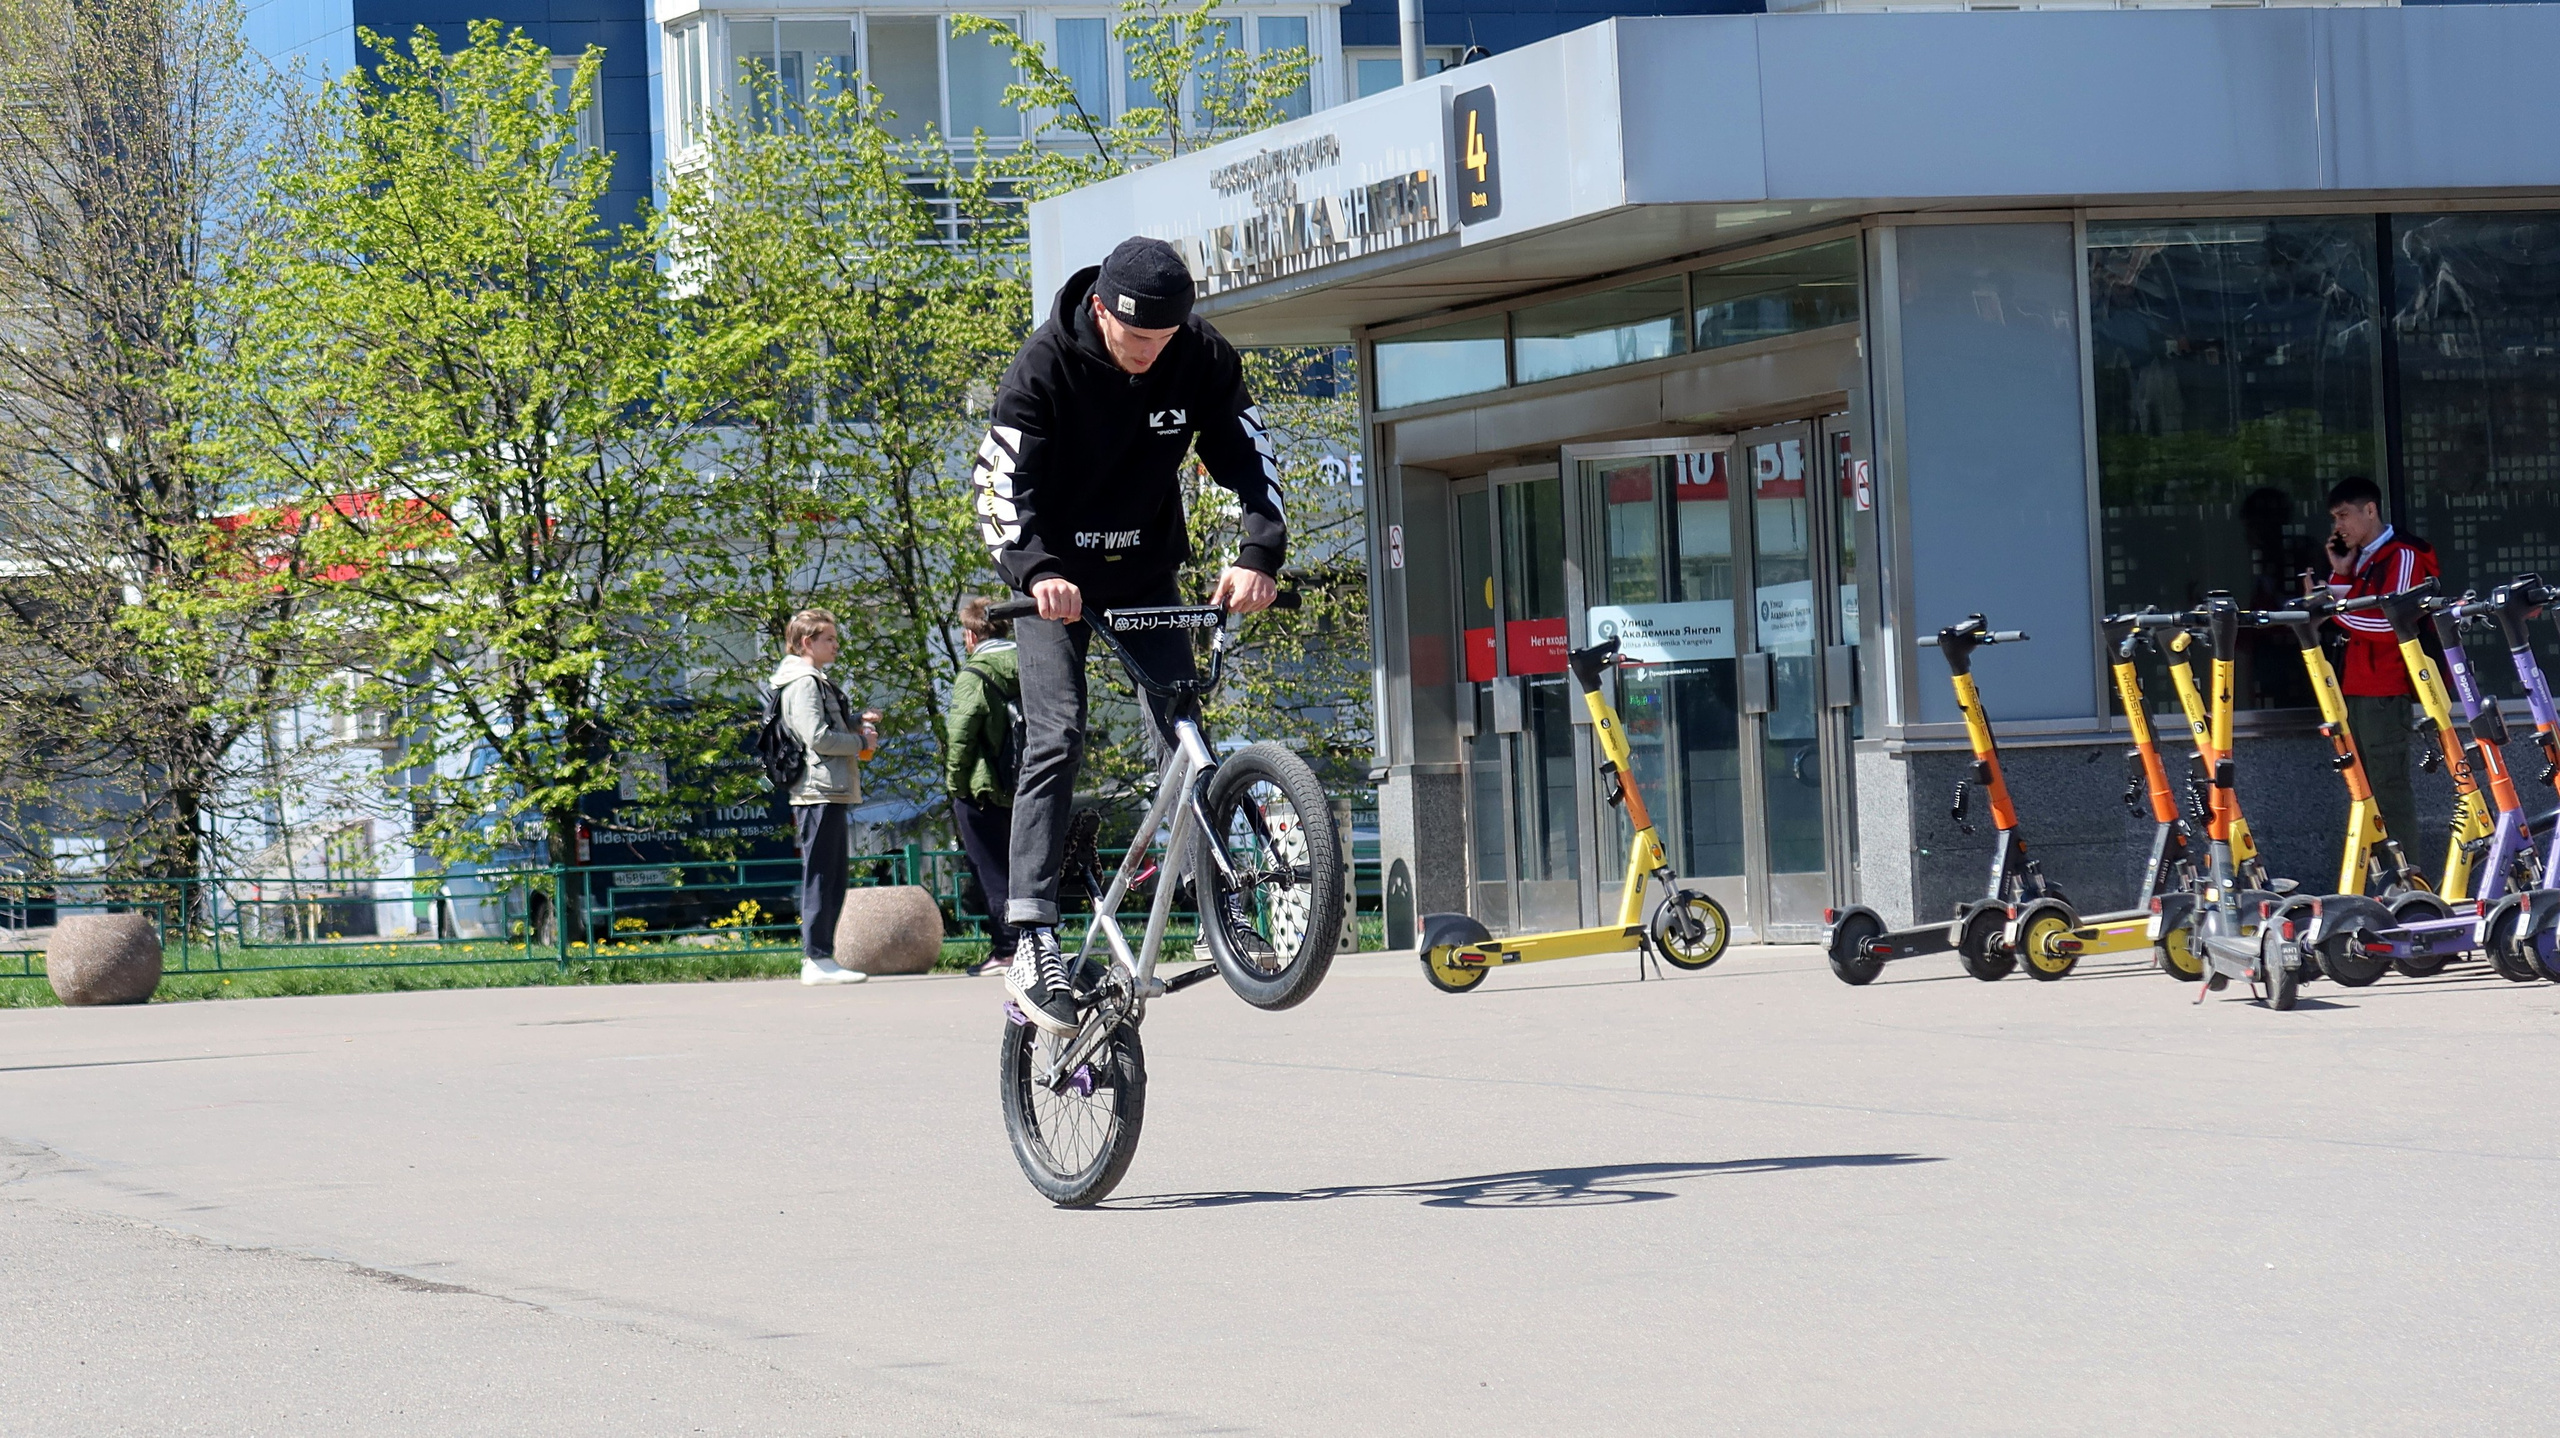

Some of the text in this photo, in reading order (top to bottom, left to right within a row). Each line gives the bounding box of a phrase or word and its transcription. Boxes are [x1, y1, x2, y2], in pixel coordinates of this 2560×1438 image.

[1467, 109, 1488, 182] 4
[1075, 529, 1141, 550] OFF-WHITE
[1128, 613, 1204, 631] ストリート忍者
[1603, 623, 1613, 638] 9
[1621, 619, 1653, 628] Улица
[1530, 635, 1568, 647] Нет входа
[1622, 626, 1722, 639] Академика Янгеля
[1622, 638, 1713, 649] Ulitsa Akademika Yangelya
[2122, 671, 2141, 718] WHOOSH
[2459, 675, 2475, 703] юрент
[2185, 693, 2198, 720] Яндекс
